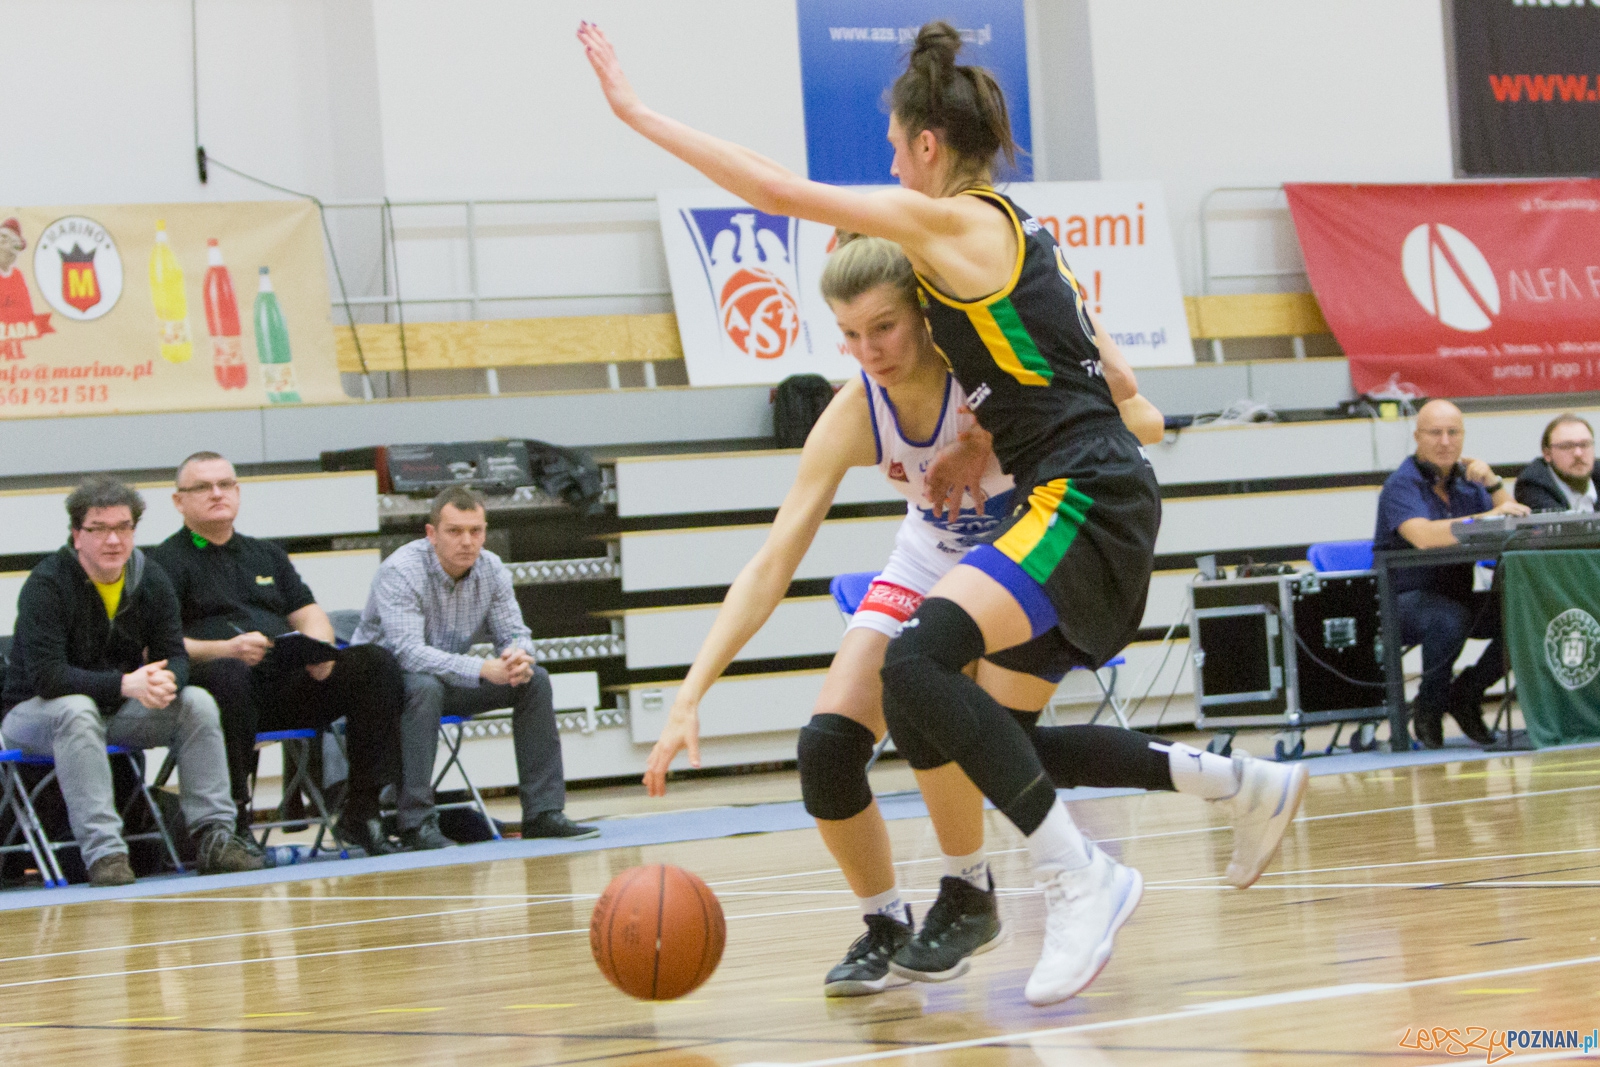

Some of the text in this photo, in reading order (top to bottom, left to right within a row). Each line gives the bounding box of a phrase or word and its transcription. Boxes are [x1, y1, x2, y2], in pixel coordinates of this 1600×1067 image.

[1488, 74, 1600, 102] www.
[46, 221, 105, 243] MARINO
[68, 268, 95, 299] M
[34, 386, 68, 404] 921
[75, 384, 108, 403] 513
